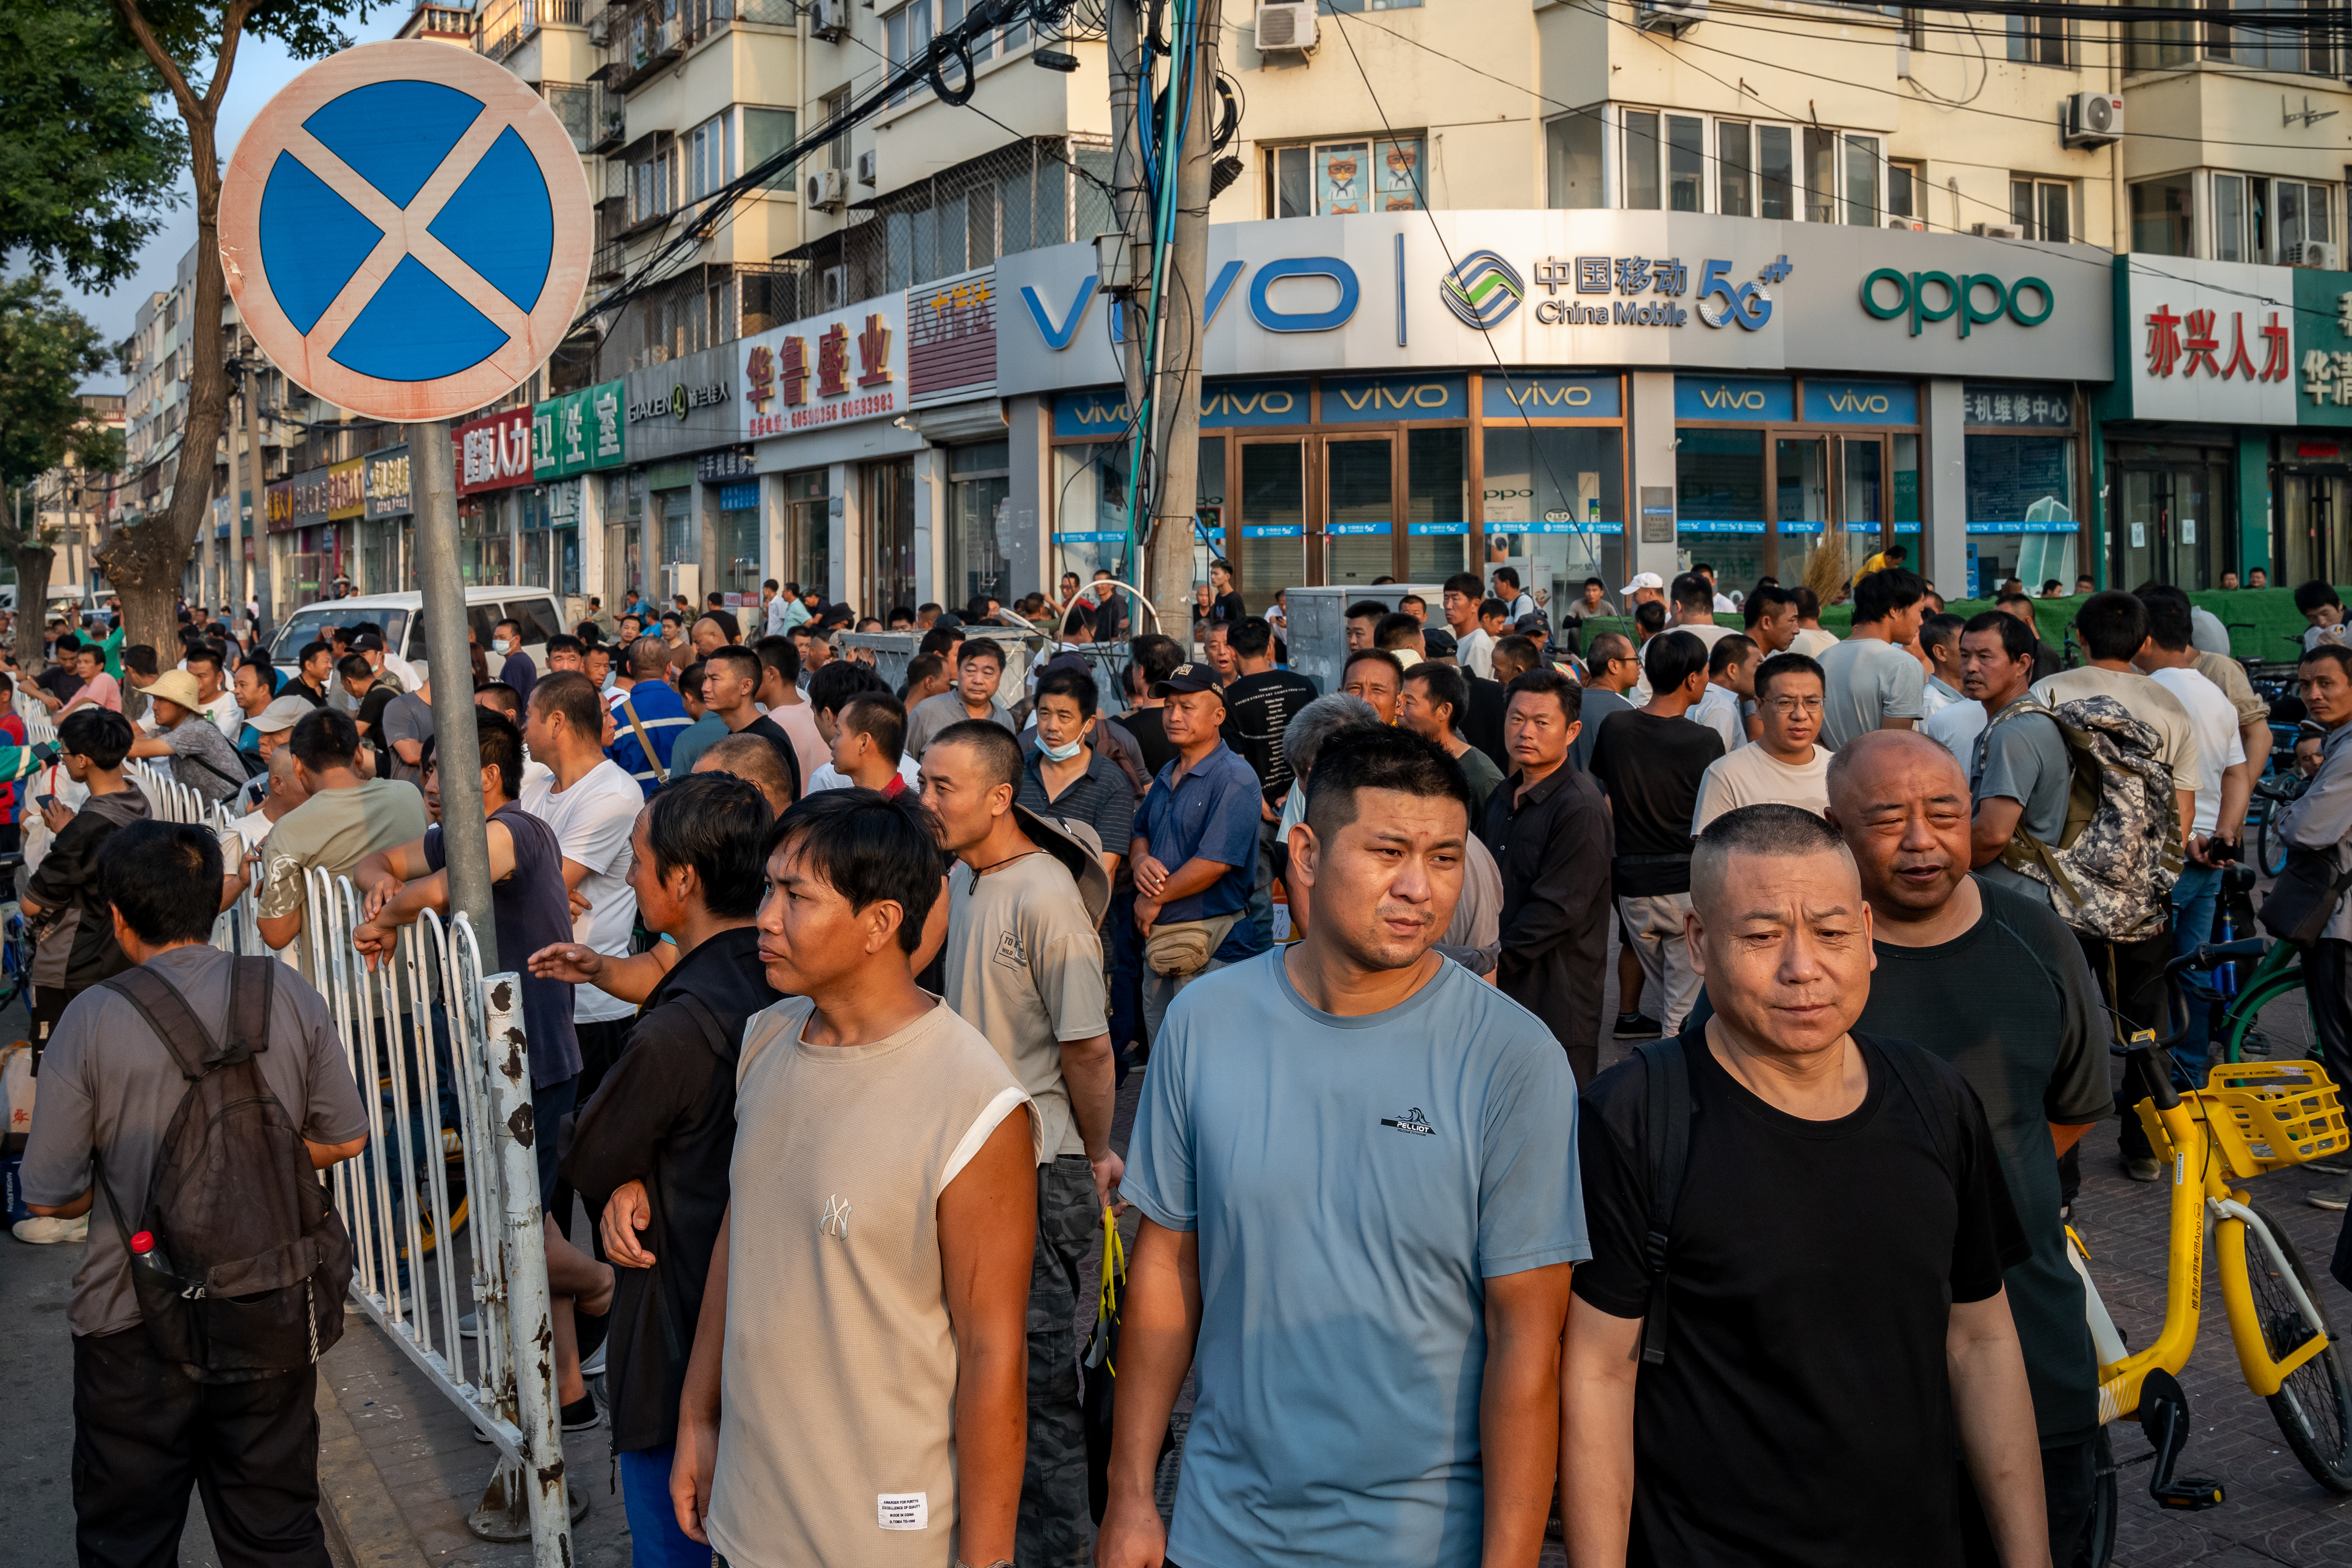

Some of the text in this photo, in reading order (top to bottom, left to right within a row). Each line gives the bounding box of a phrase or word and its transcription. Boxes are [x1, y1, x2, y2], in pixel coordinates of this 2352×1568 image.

[1534, 255, 1687, 295] 中国移动
[1536, 300, 1687, 327] China Mobile
[1860, 268, 2054, 337] oppo
[2145, 304, 2289, 382] 亦兴人力
[746, 313, 893, 414] 华鲁盛业
[1340, 381, 1449, 410] vivo
[1506, 381, 1592, 407] vivo
[1700, 385, 1765, 409] vivo
[1828, 389, 1889, 413] vivo
[628, 396, 671, 423] GIALEN
[1484, 489, 1534, 501] ppo
[1002, 947, 1013, 956] WILD
[1004, 936, 1013, 946] TO
[1397, 1121, 1429, 1133] PELLIOT
